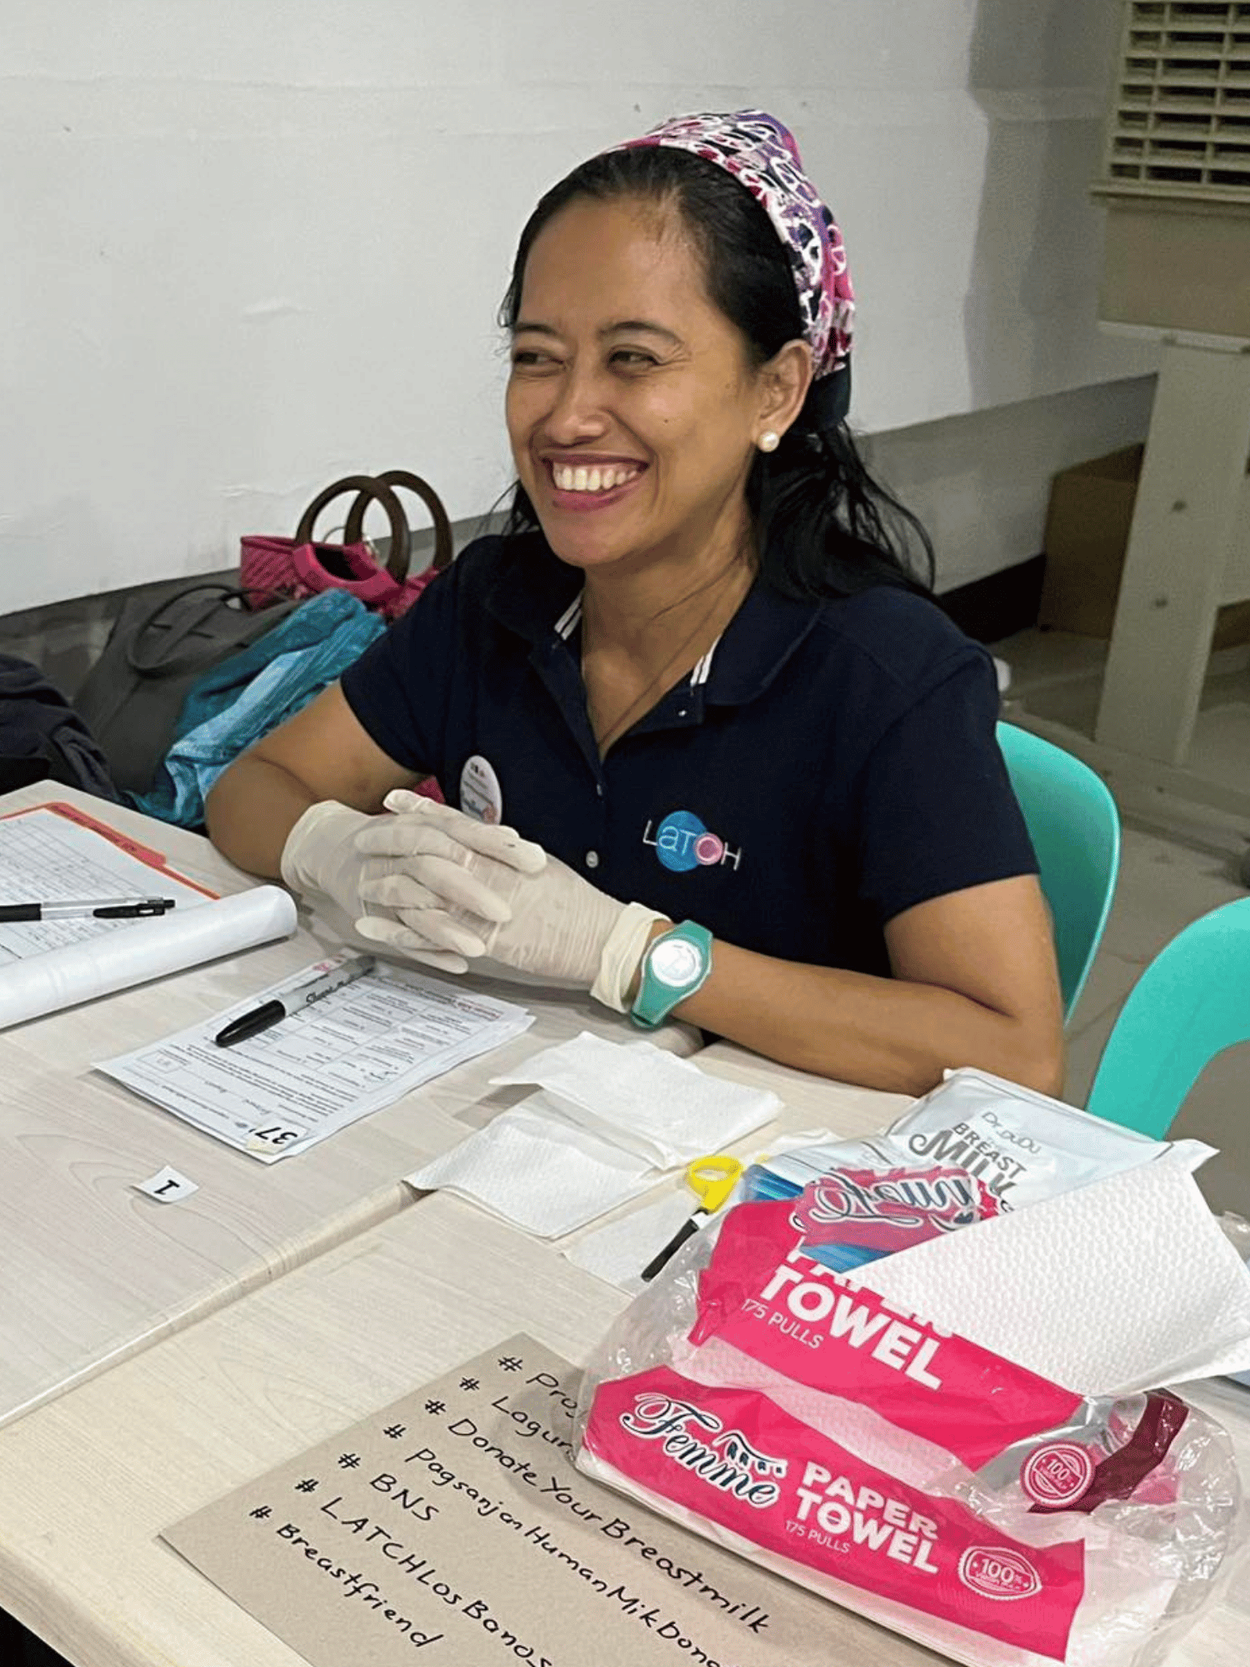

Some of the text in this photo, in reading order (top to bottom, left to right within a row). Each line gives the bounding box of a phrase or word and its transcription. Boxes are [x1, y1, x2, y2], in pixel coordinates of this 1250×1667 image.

[952, 1122, 1027, 1179] BREAST
[741, 1298, 824, 1349] 175 PULLS
[760, 1264, 943, 1391] TOWEL
[620, 1392, 779, 1509] Femme
[370, 1473, 440, 1522] BNS
[796, 1487, 938, 1574] TOWEL
[802, 1461, 938, 1540] PAPER
[785, 1520, 850, 1553] 175 PULLS
